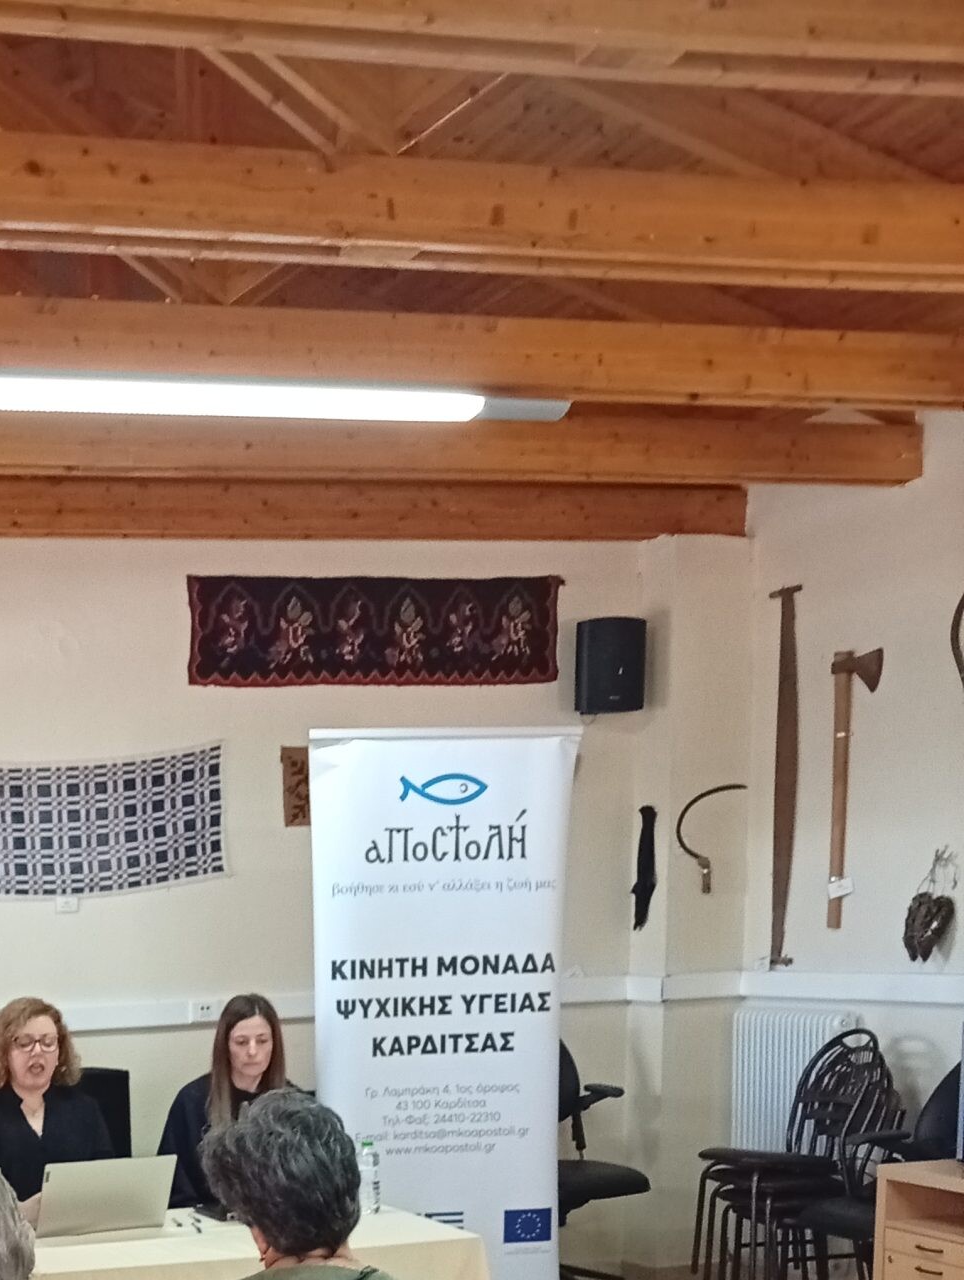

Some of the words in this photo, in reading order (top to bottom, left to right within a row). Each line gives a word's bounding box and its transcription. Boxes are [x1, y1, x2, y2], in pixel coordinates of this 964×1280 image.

[495, 879, 503, 892] η
[506, 877, 532, 892] ζωή
[535, 878, 557, 892] μας
[331, 957, 428, 981] ΚΙΝΗΤΗ
[436, 952, 556, 977] ΜΟΝΑΔΑ
[336, 995, 453, 1020] ΨΥΧΙΚΗΣ
[460, 991, 552, 1015] ΥΓΕΙΑΣ
[371, 1032, 516, 1058] ΚΑΡΔΙΤΣΑΣ
[382, 1084, 440, 1098] Λαμπράκη
[455, 1084, 473, 1095] 1ος
[476, 1082, 521, 1095] όροφος
[395, 1100, 409, 1111] 43
[412, 1099, 431, 1110] 100
[434, 1097, 487, 1111] Καρδίτσα
[434, 1111, 502, 1124] 24410-22310
[385, 1141, 497, 1155] www.mkoapostoli.gr
